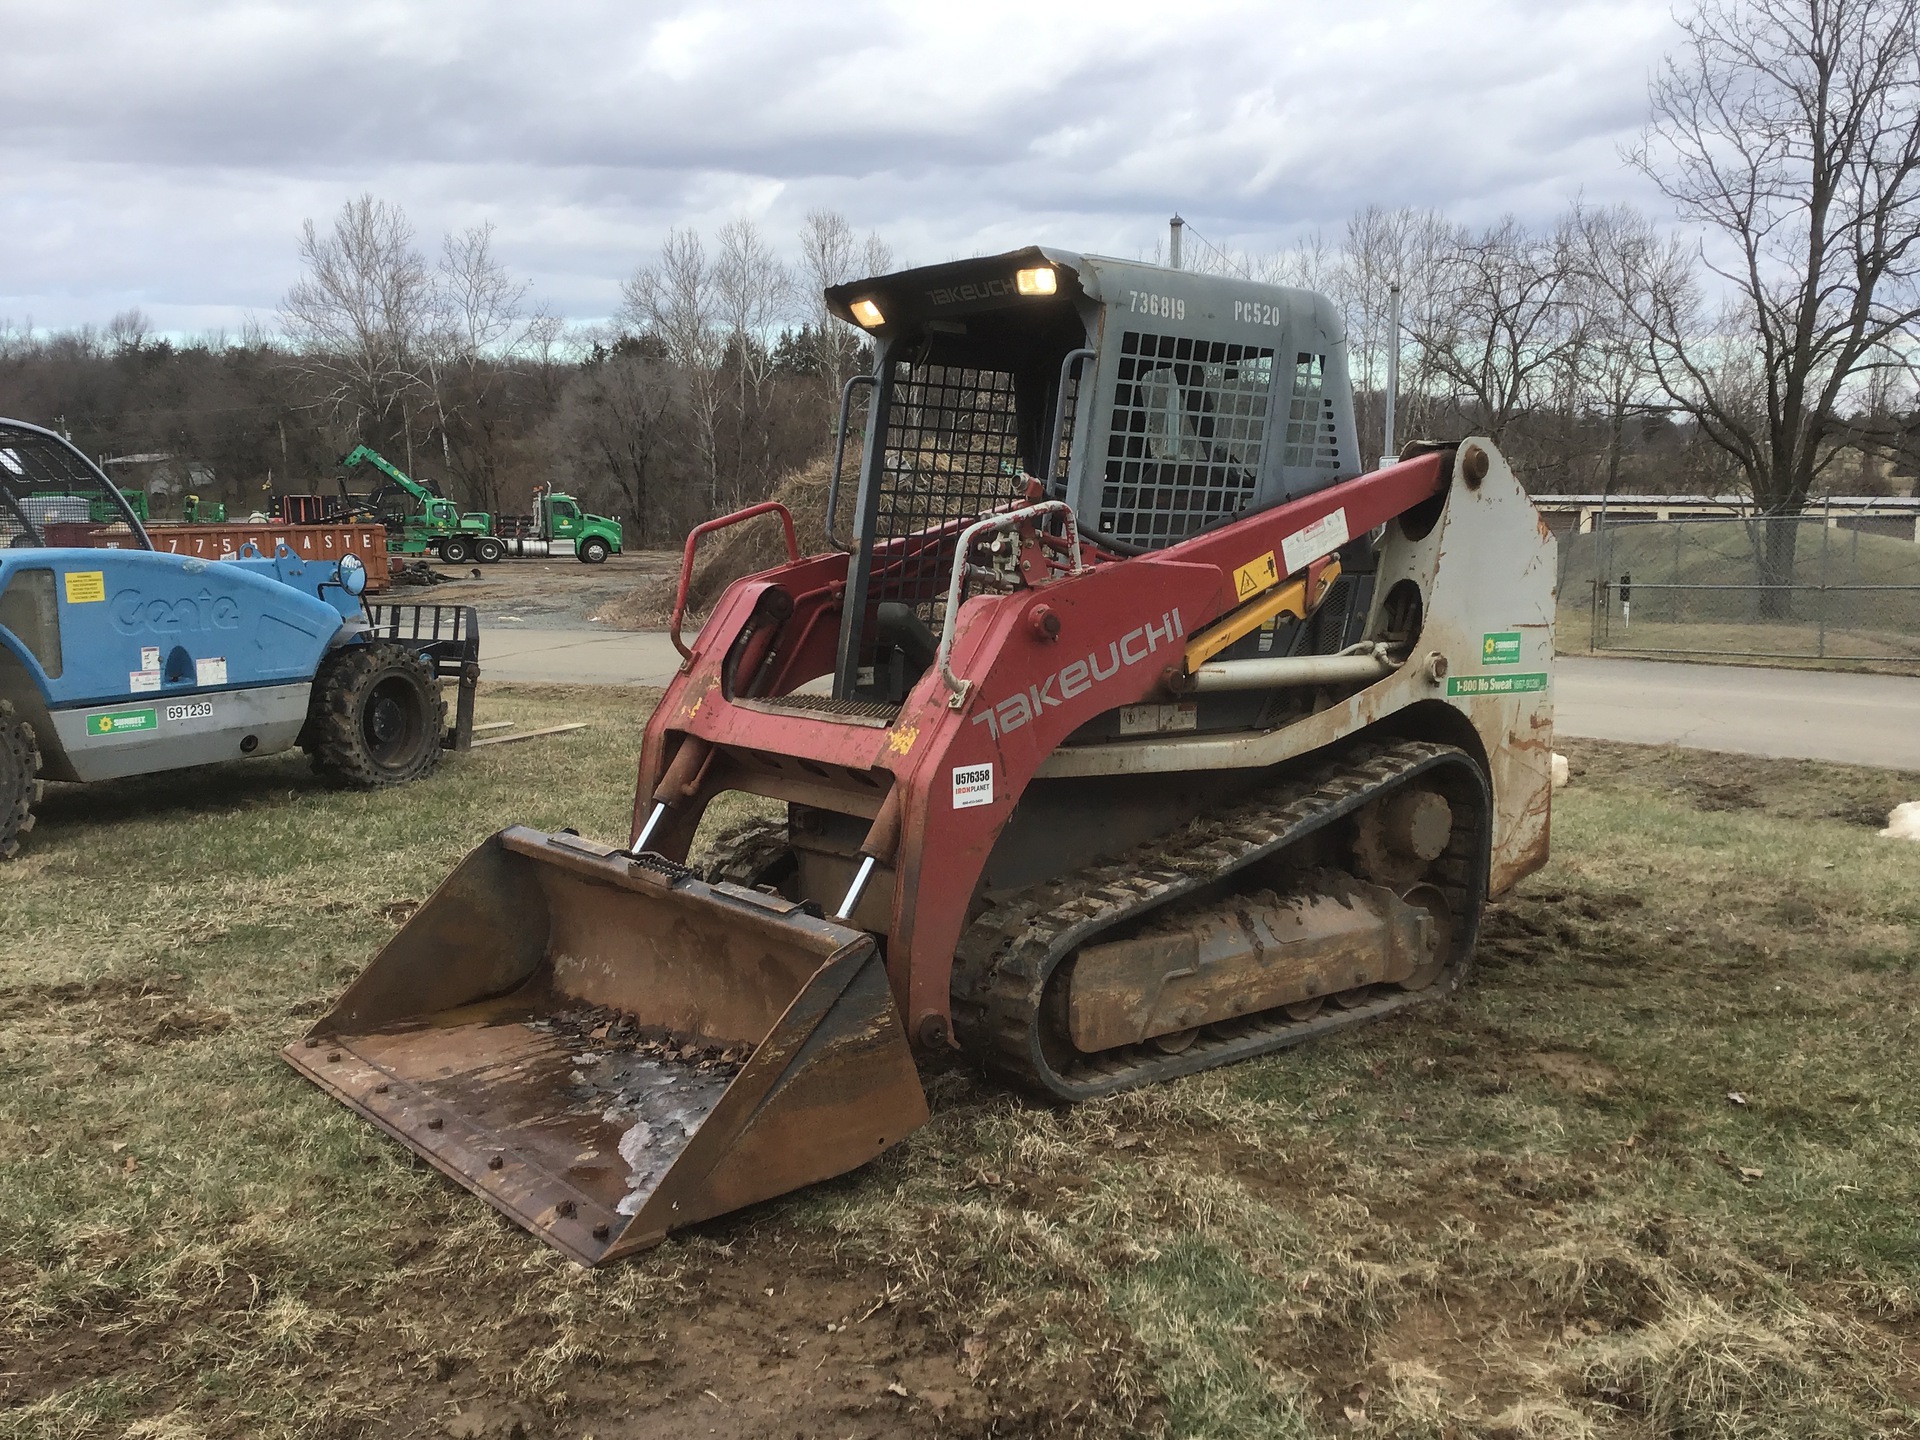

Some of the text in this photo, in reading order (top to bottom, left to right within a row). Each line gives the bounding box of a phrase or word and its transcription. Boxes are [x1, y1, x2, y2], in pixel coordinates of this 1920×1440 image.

[925, 278, 1018, 305] TAKEUCH
[1129, 290, 1185, 321] 736819
[1234, 300, 1280, 327] PC520
[972, 607, 1184, 741] TAKEUCHI
[1457, 680, 1477, 692] 1-800
[1478, 678, 1488, 691] No
[1490, 678, 1513, 690] Sweat
[168, 704, 211, 719] 691239
[955, 769, 990, 785] U576358
